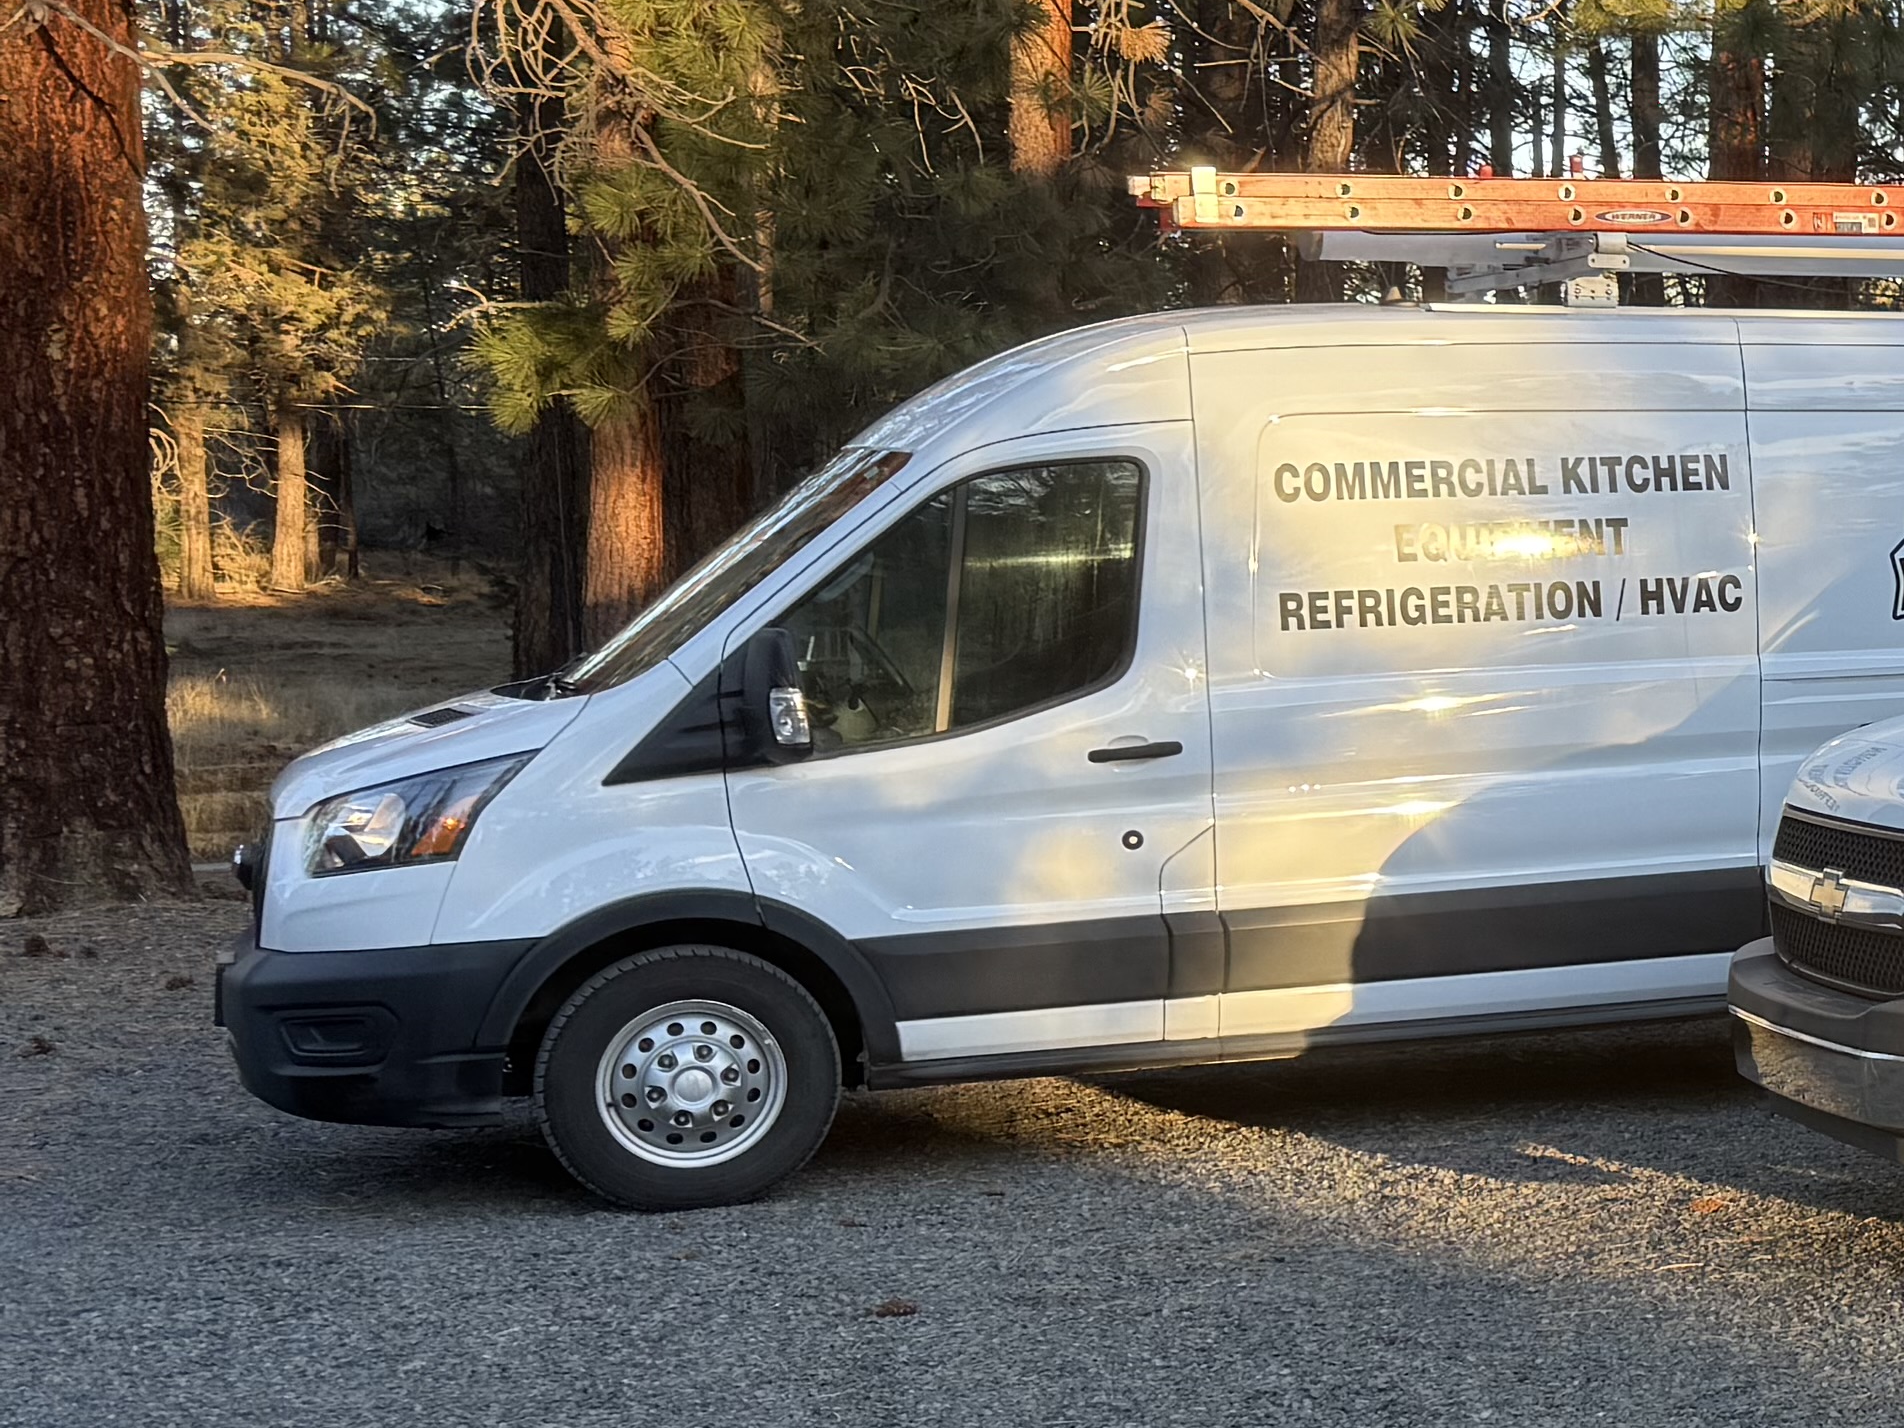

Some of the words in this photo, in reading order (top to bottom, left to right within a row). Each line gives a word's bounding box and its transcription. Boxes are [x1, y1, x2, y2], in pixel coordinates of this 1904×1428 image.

[1275, 458, 1549, 503] COMMERCIAL
[1560, 454, 1730, 494] KITCHEN
[1394, 518, 1628, 562] EQUIENT
[1279, 580, 1602, 631] REFRIGERATION
[1616, 578, 1626, 621] /
[1640, 574, 1743, 616] HVAC
